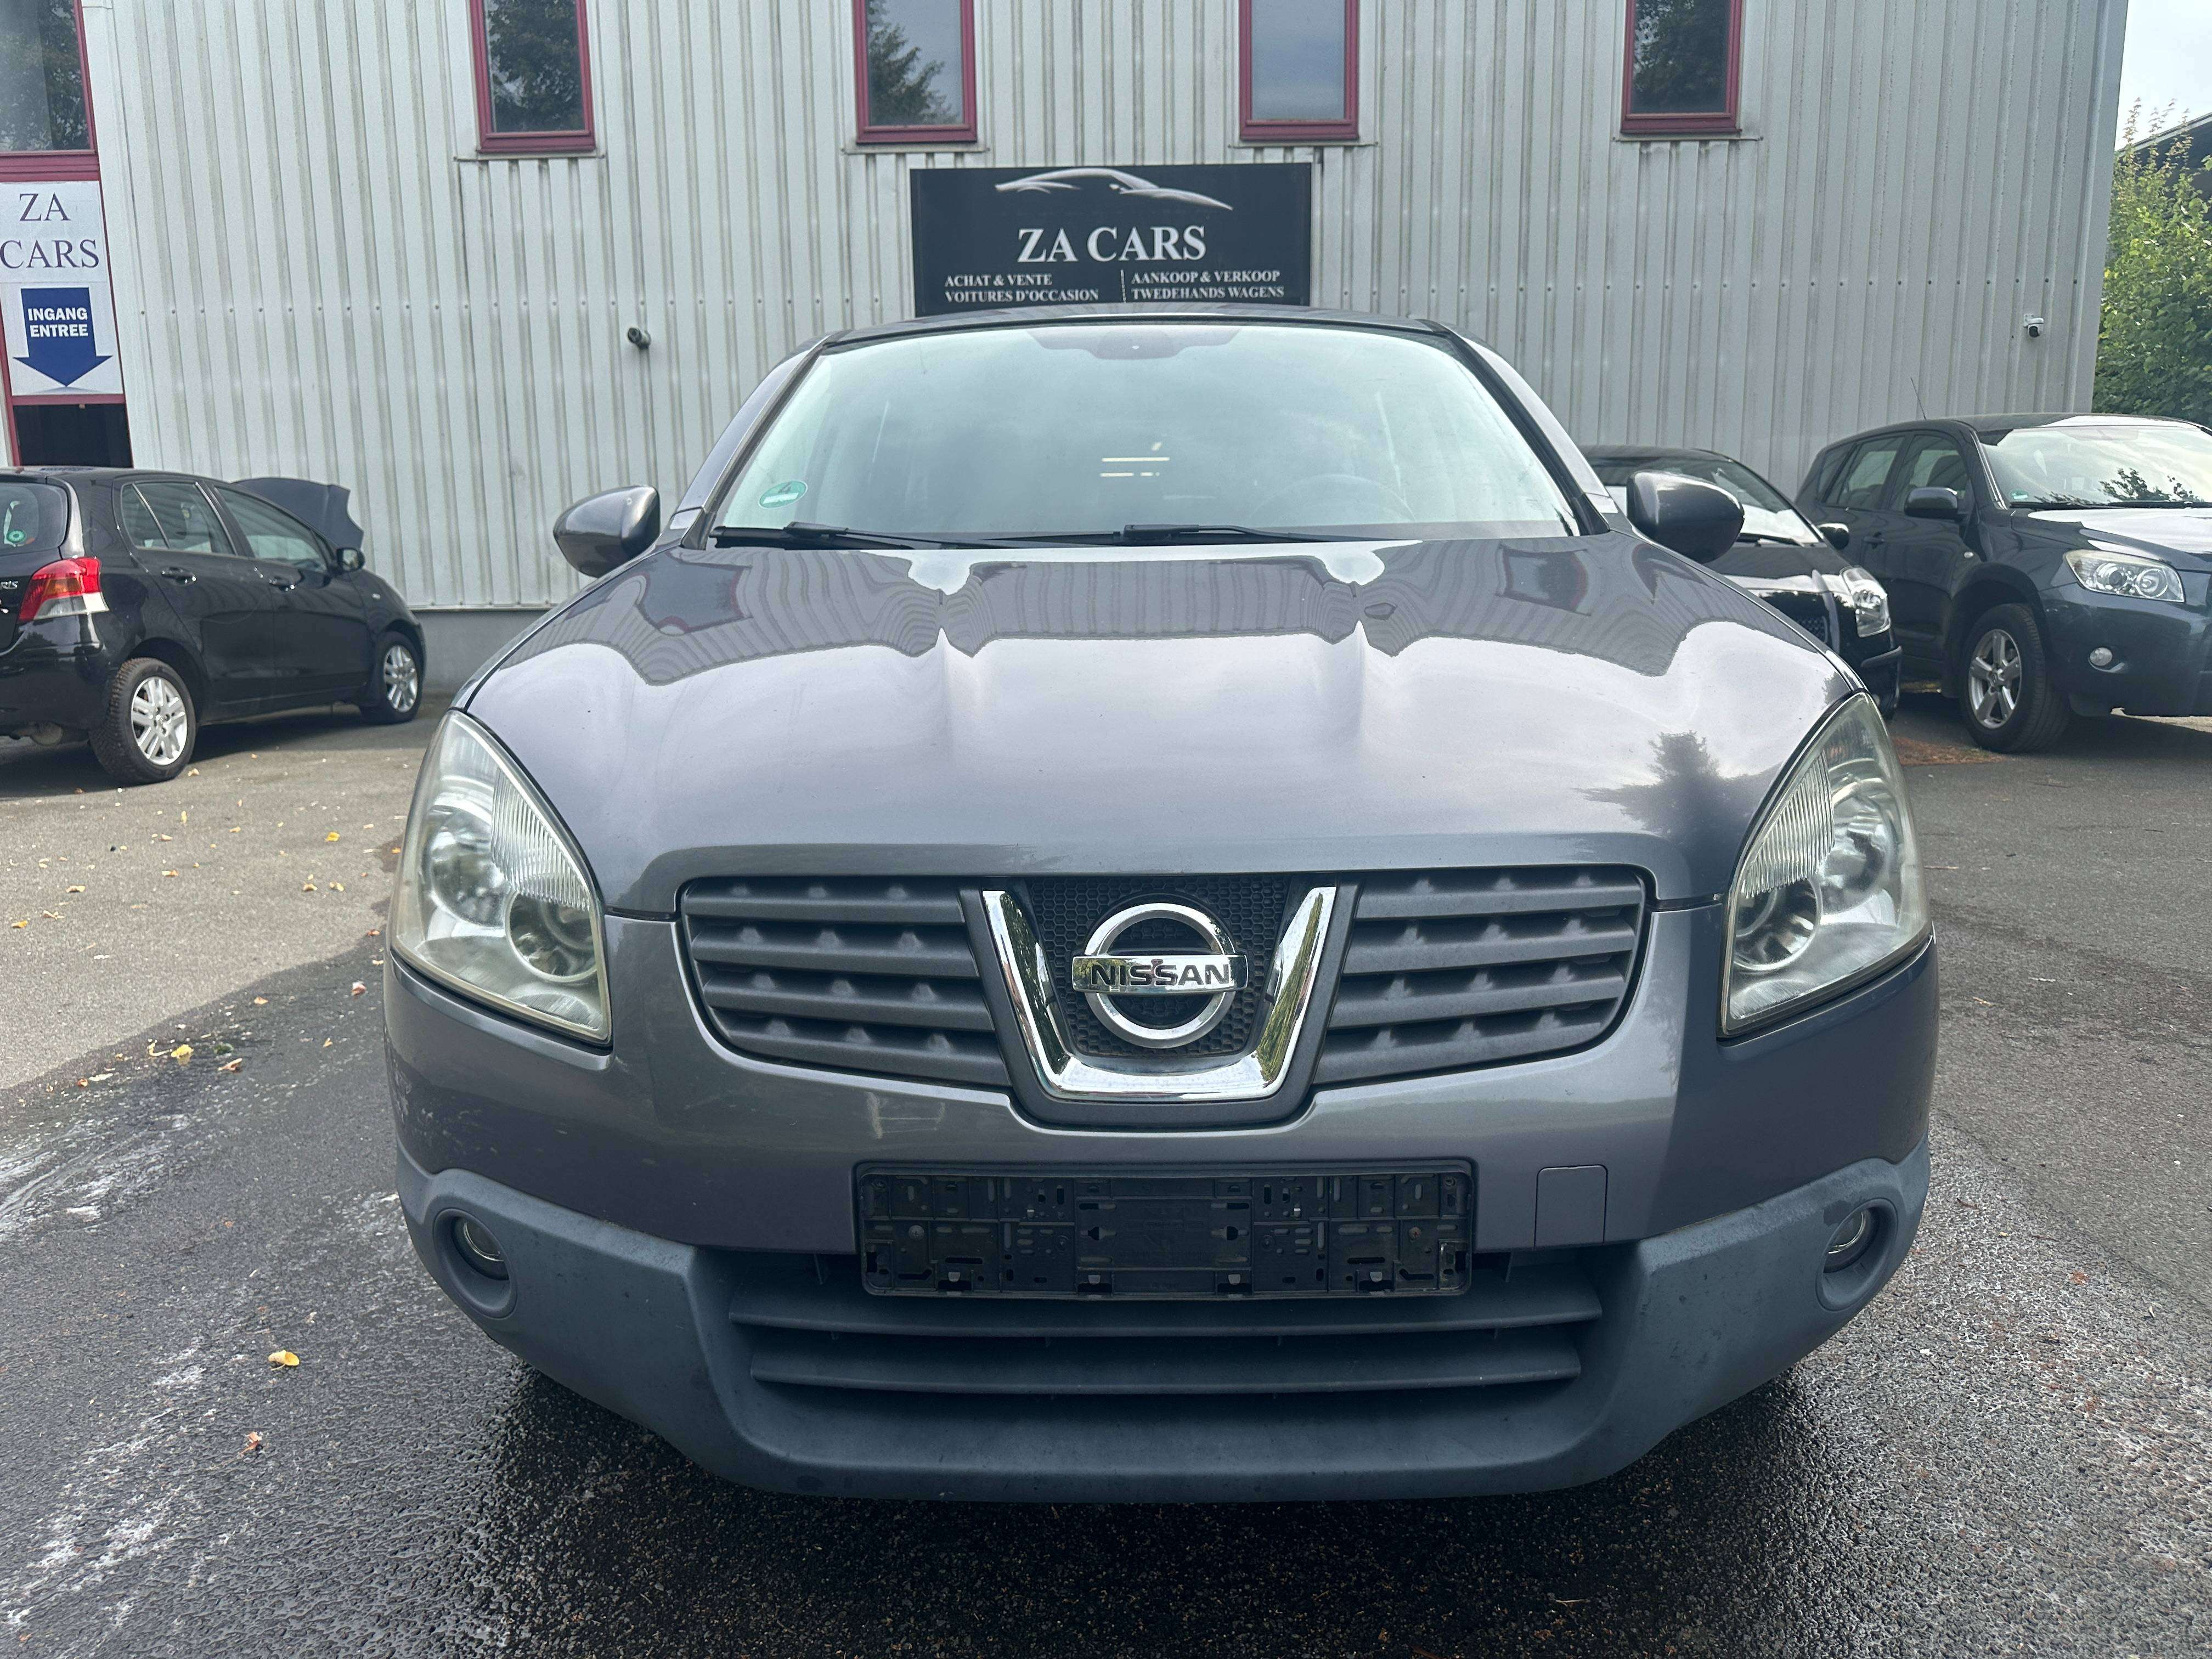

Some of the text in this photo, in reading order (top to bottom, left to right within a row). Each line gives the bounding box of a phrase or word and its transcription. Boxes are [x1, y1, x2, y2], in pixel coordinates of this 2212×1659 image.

[19, 193, 71, 222] ZA
[1017, 225, 1207, 263] ZA CARS
[0, 239, 100, 269] CARS
[945, 273, 1052, 287] ACHAT & VENTE
[1131, 269, 1280, 284] AANKOOP & VERKOOP
[945, 289, 1099, 302] VOITURES D'OCCASION
[1131, 285, 1285, 300] TWEDEHANDS WAGENS
[28, 308, 88, 321] INGANG
[30, 323, 88, 337] ENTREE
[1091, 964, 1229, 986] NISSAN
